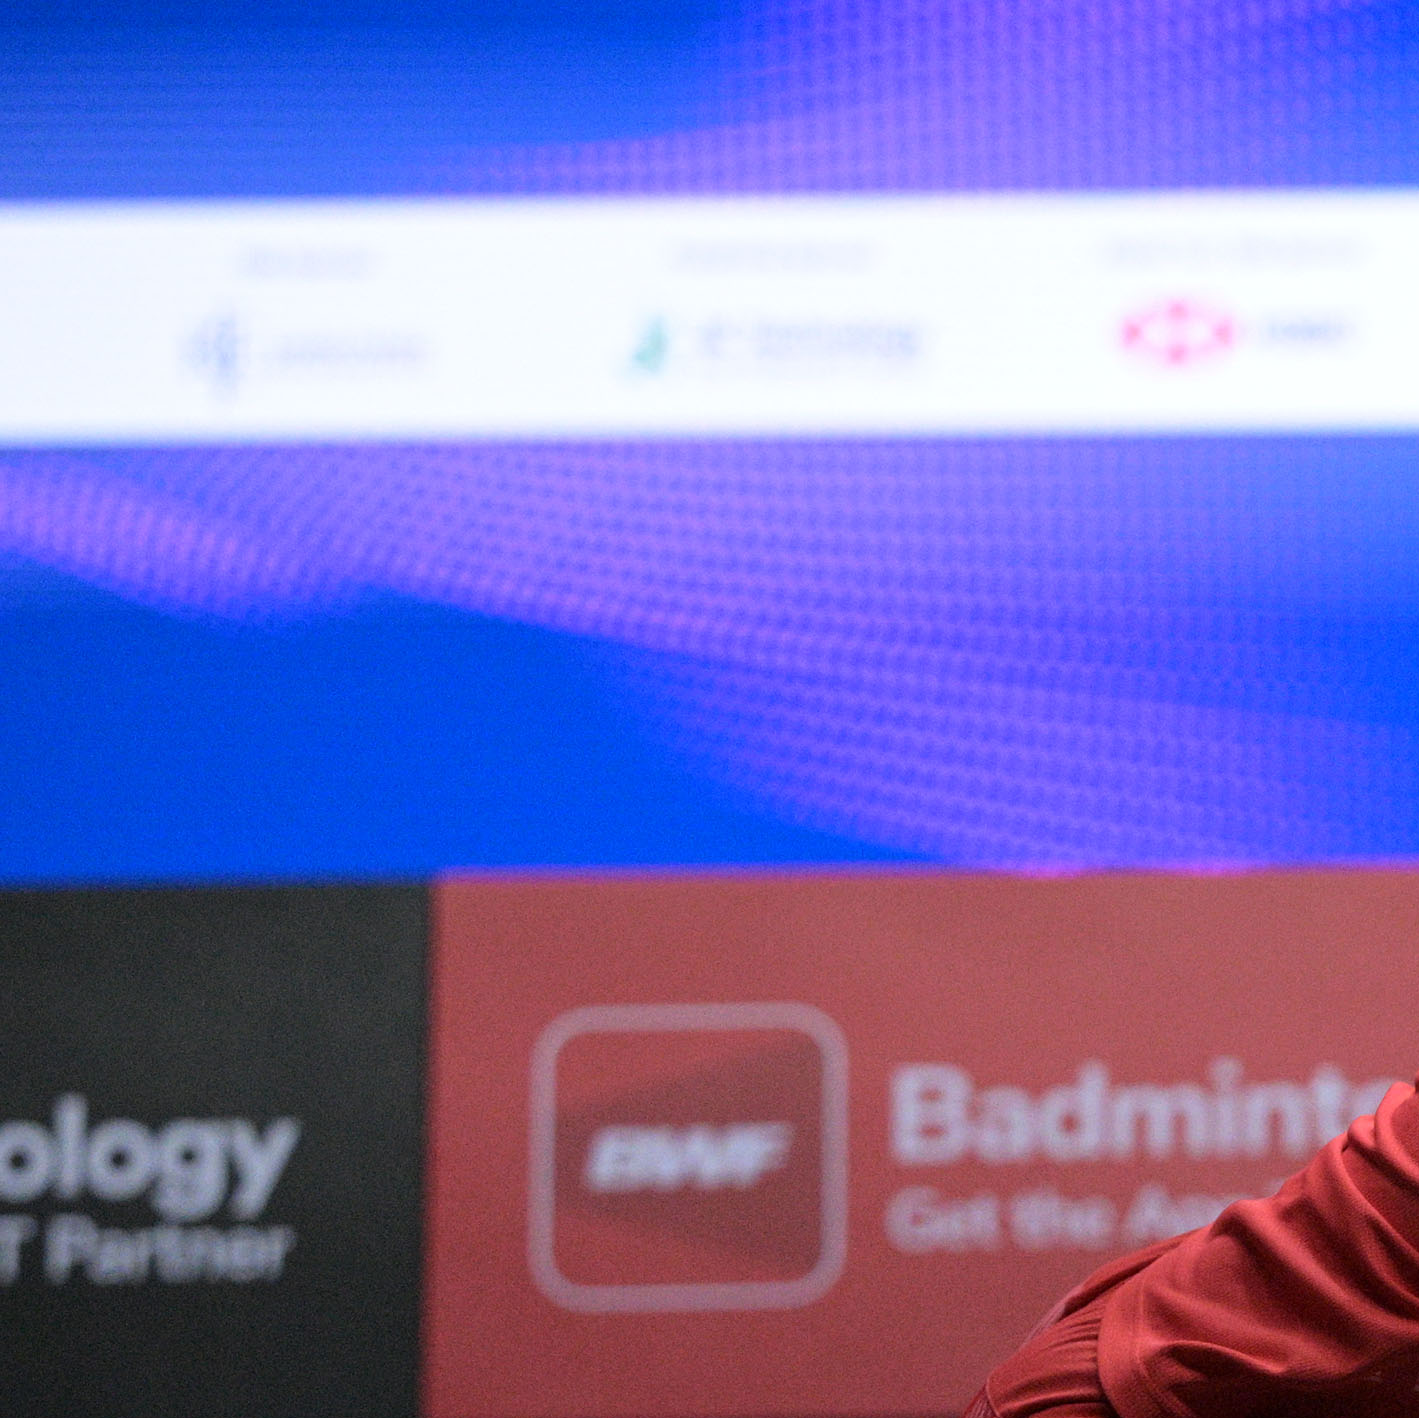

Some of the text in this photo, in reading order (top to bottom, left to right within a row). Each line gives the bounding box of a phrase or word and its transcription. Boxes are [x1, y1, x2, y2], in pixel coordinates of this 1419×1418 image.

[586, 1124, 793, 1190] BWF
[47, 1213, 295, 1284] Partner
[887, 1187, 996, 1252] Get
[1010, 1187, 1117, 1250] the
